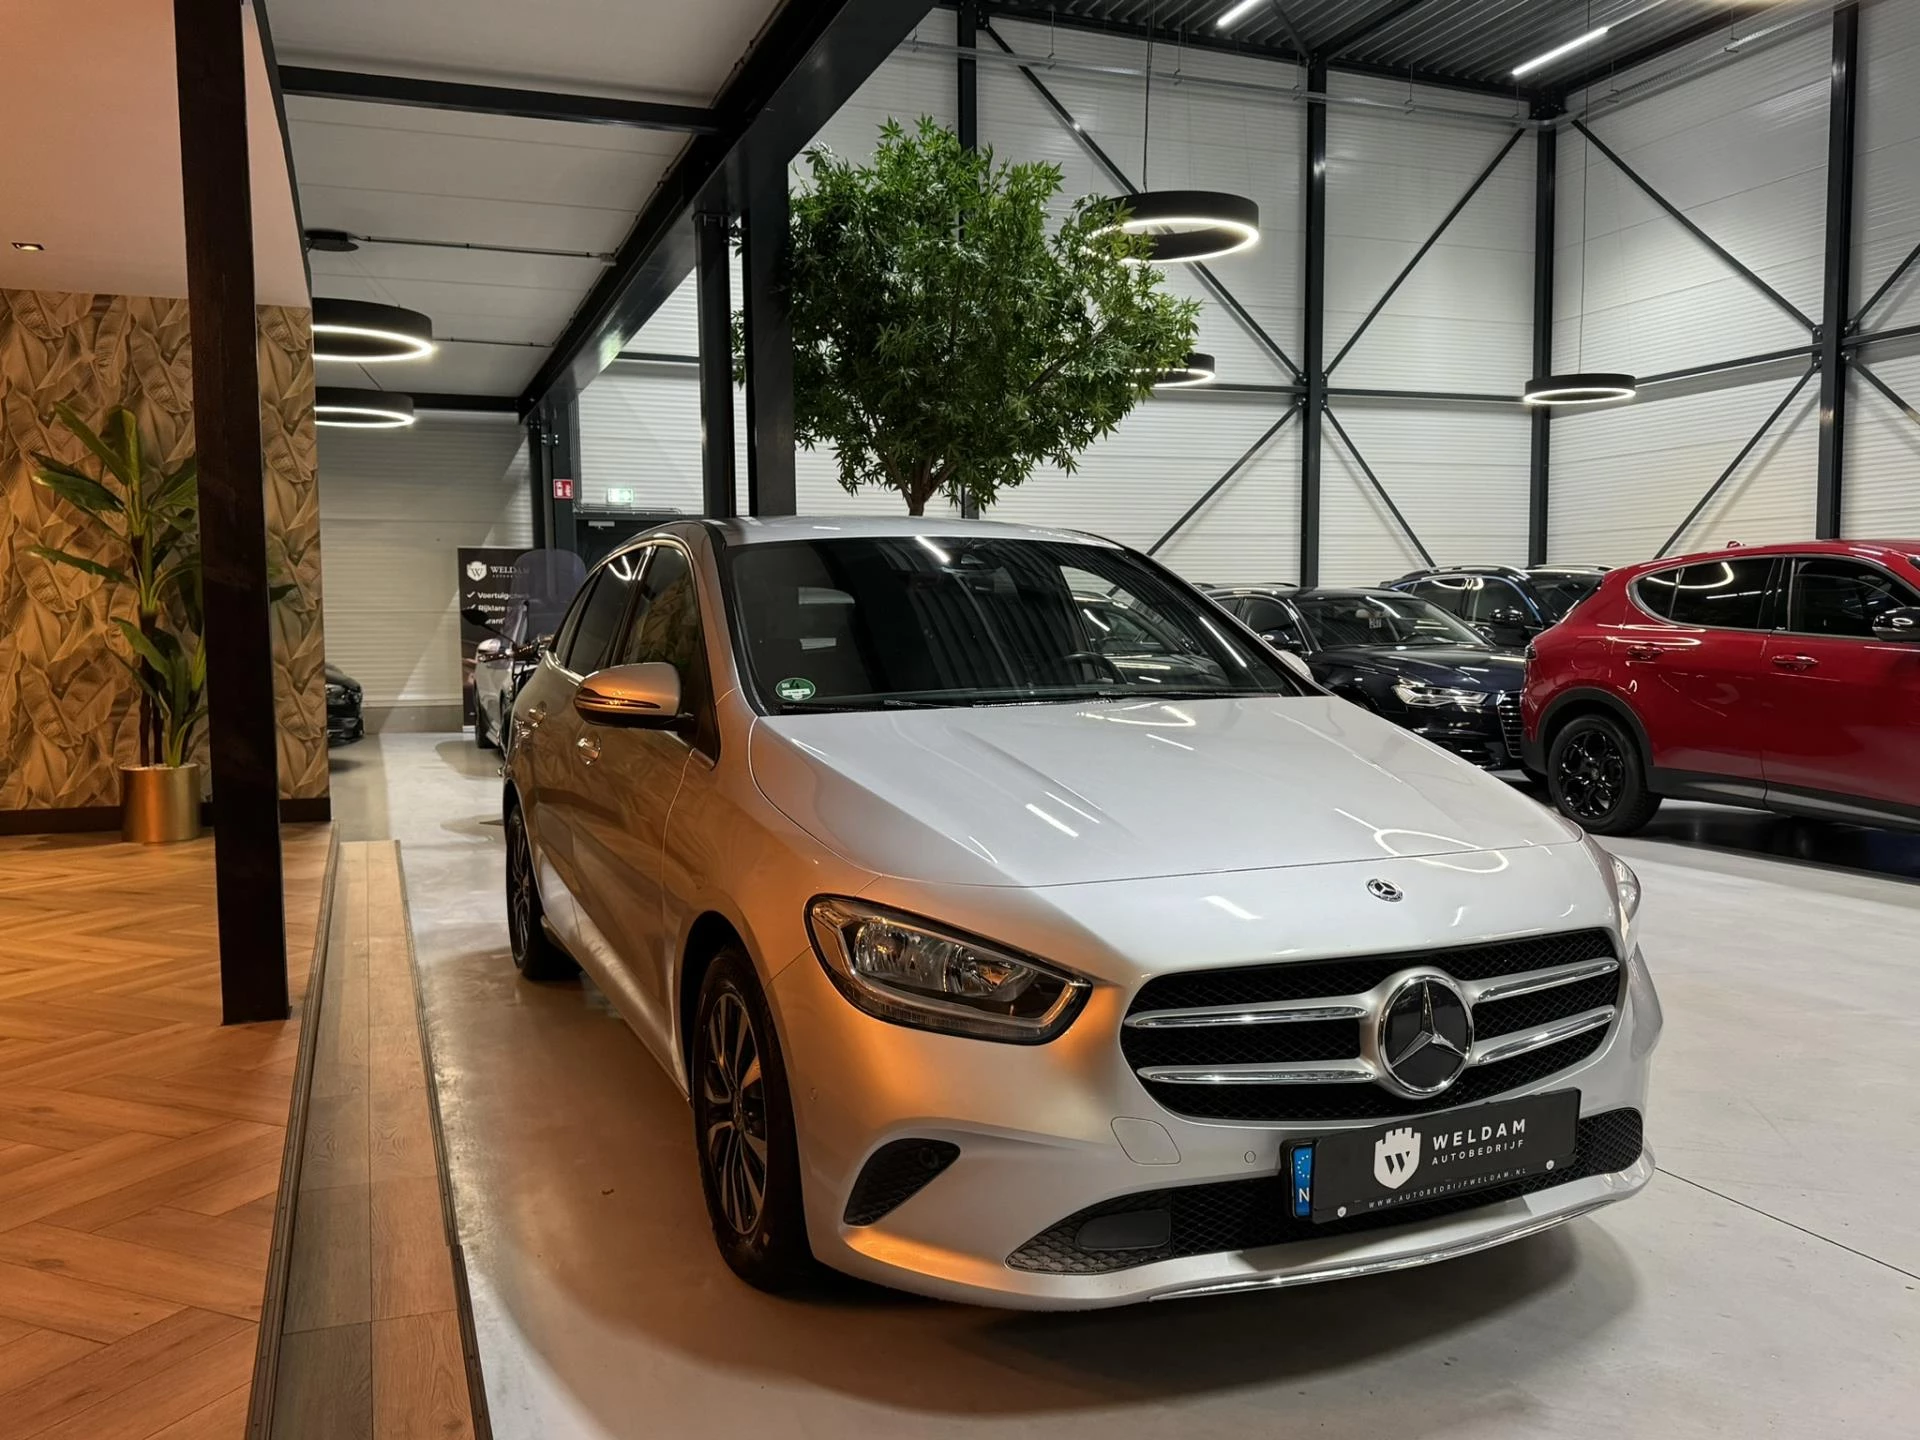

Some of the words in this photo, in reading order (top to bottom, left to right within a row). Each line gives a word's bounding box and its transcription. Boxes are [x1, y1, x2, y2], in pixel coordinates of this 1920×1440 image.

[1432, 1118, 1526, 1151] WELDAM
[1384, 1150, 1411, 1175] W
[1431, 1139, 1525, 1166] AUTOBEDRIJF
[1298, 1187, 1310, 1203] N
